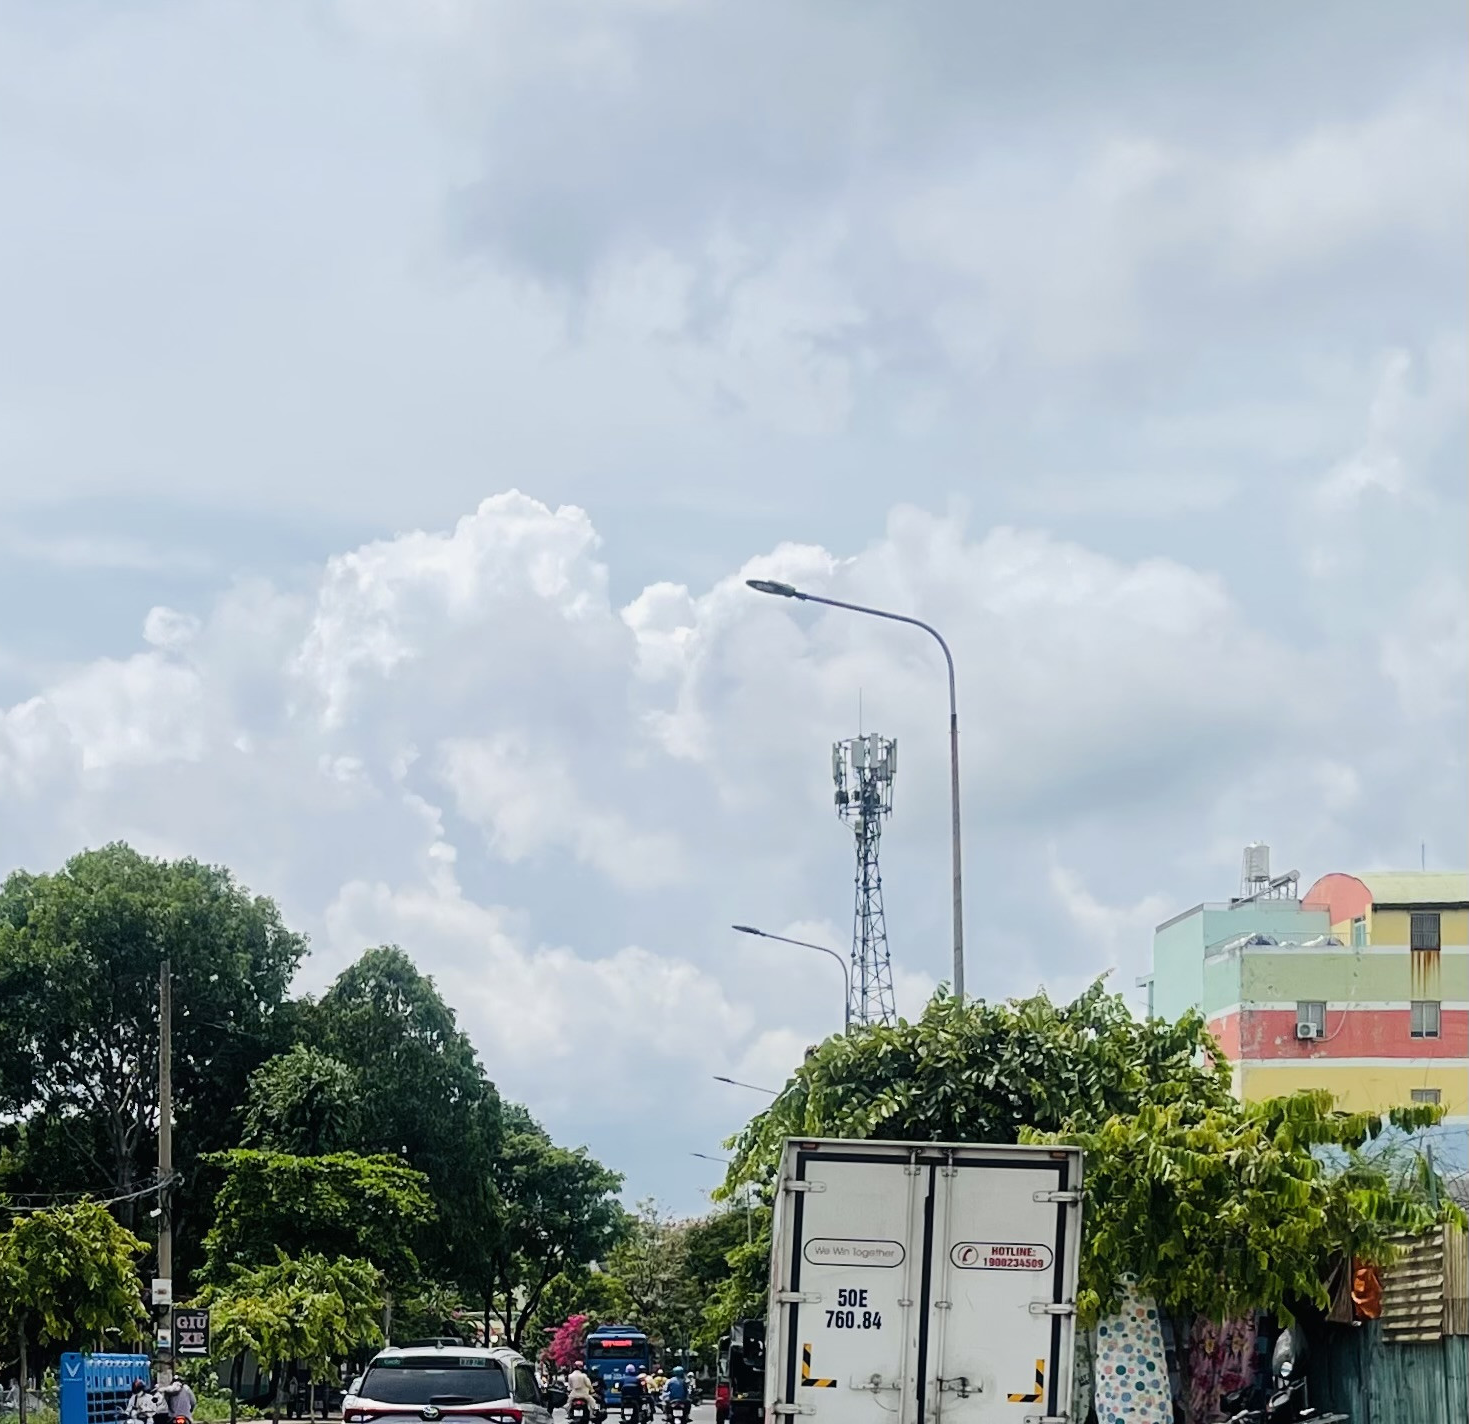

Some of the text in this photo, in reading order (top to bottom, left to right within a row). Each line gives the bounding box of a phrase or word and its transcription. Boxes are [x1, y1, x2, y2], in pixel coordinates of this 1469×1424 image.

[815, 1246, 895, 1258] We Win Together
[991, 1246, 1037, 1257] HOTLINE:
[837, 1288, 868, 1308] 50E
[825, 1310, 882, 1329] 760.84
[179, 1332, 205, 1345] XE
